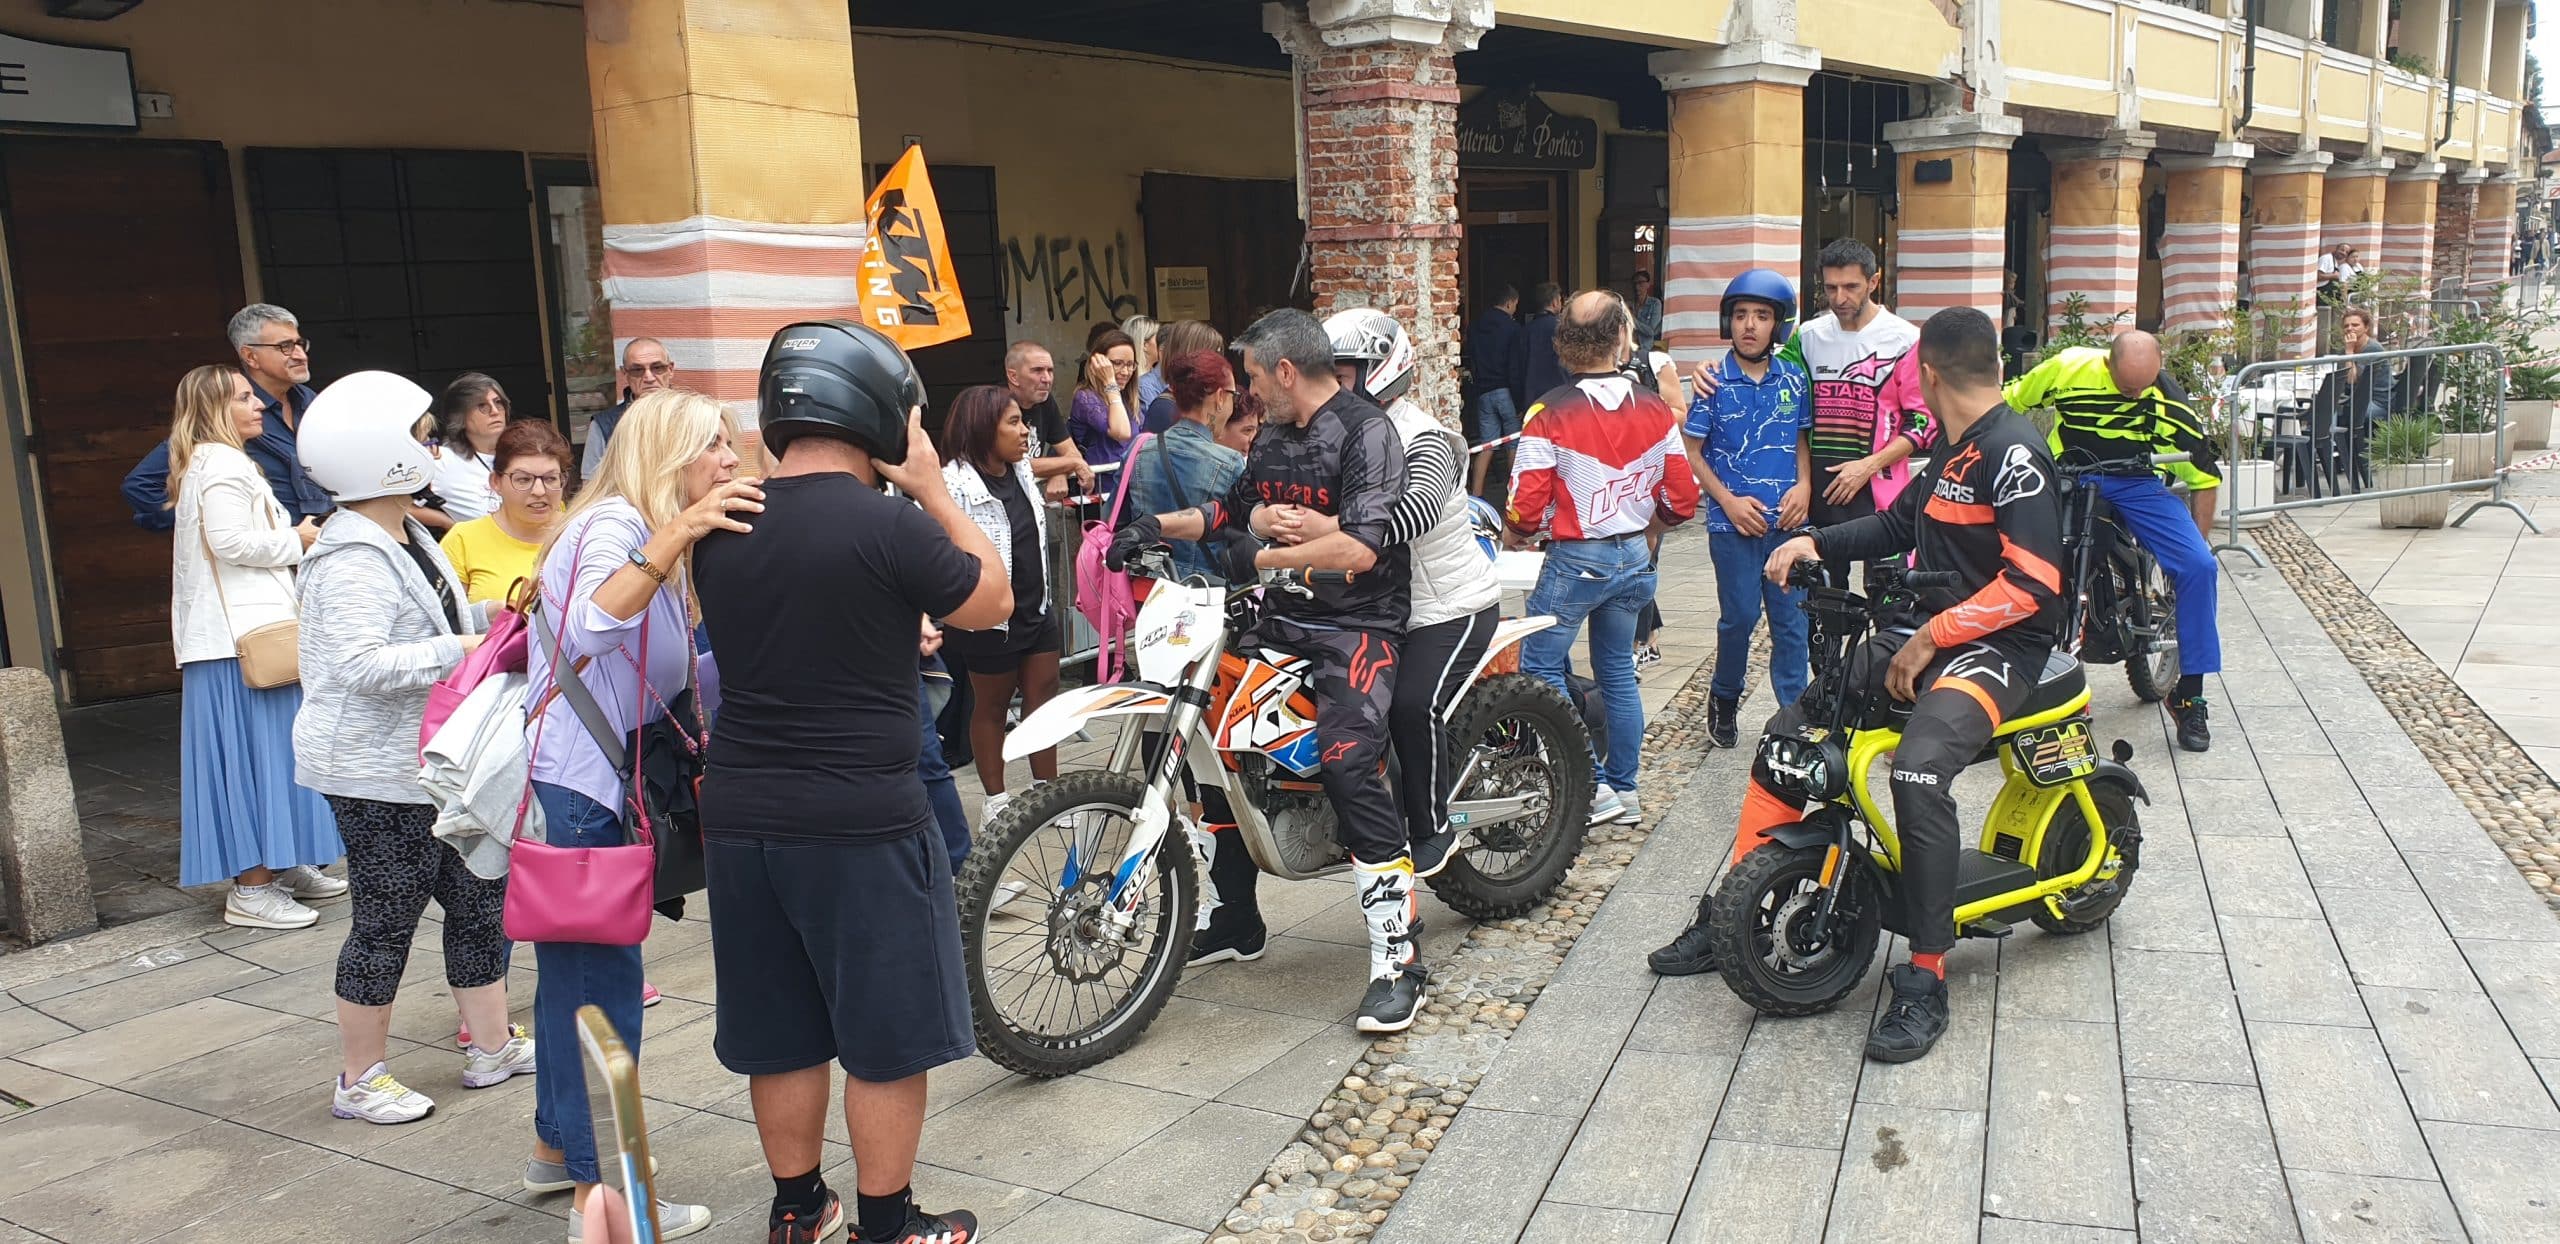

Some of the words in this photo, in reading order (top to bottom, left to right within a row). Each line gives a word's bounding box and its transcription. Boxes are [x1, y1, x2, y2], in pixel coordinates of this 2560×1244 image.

[151, 99, 158, 113] 1
[1533, 112, 1584, 159] Portici
[877, 188, 941, 326] KTM
